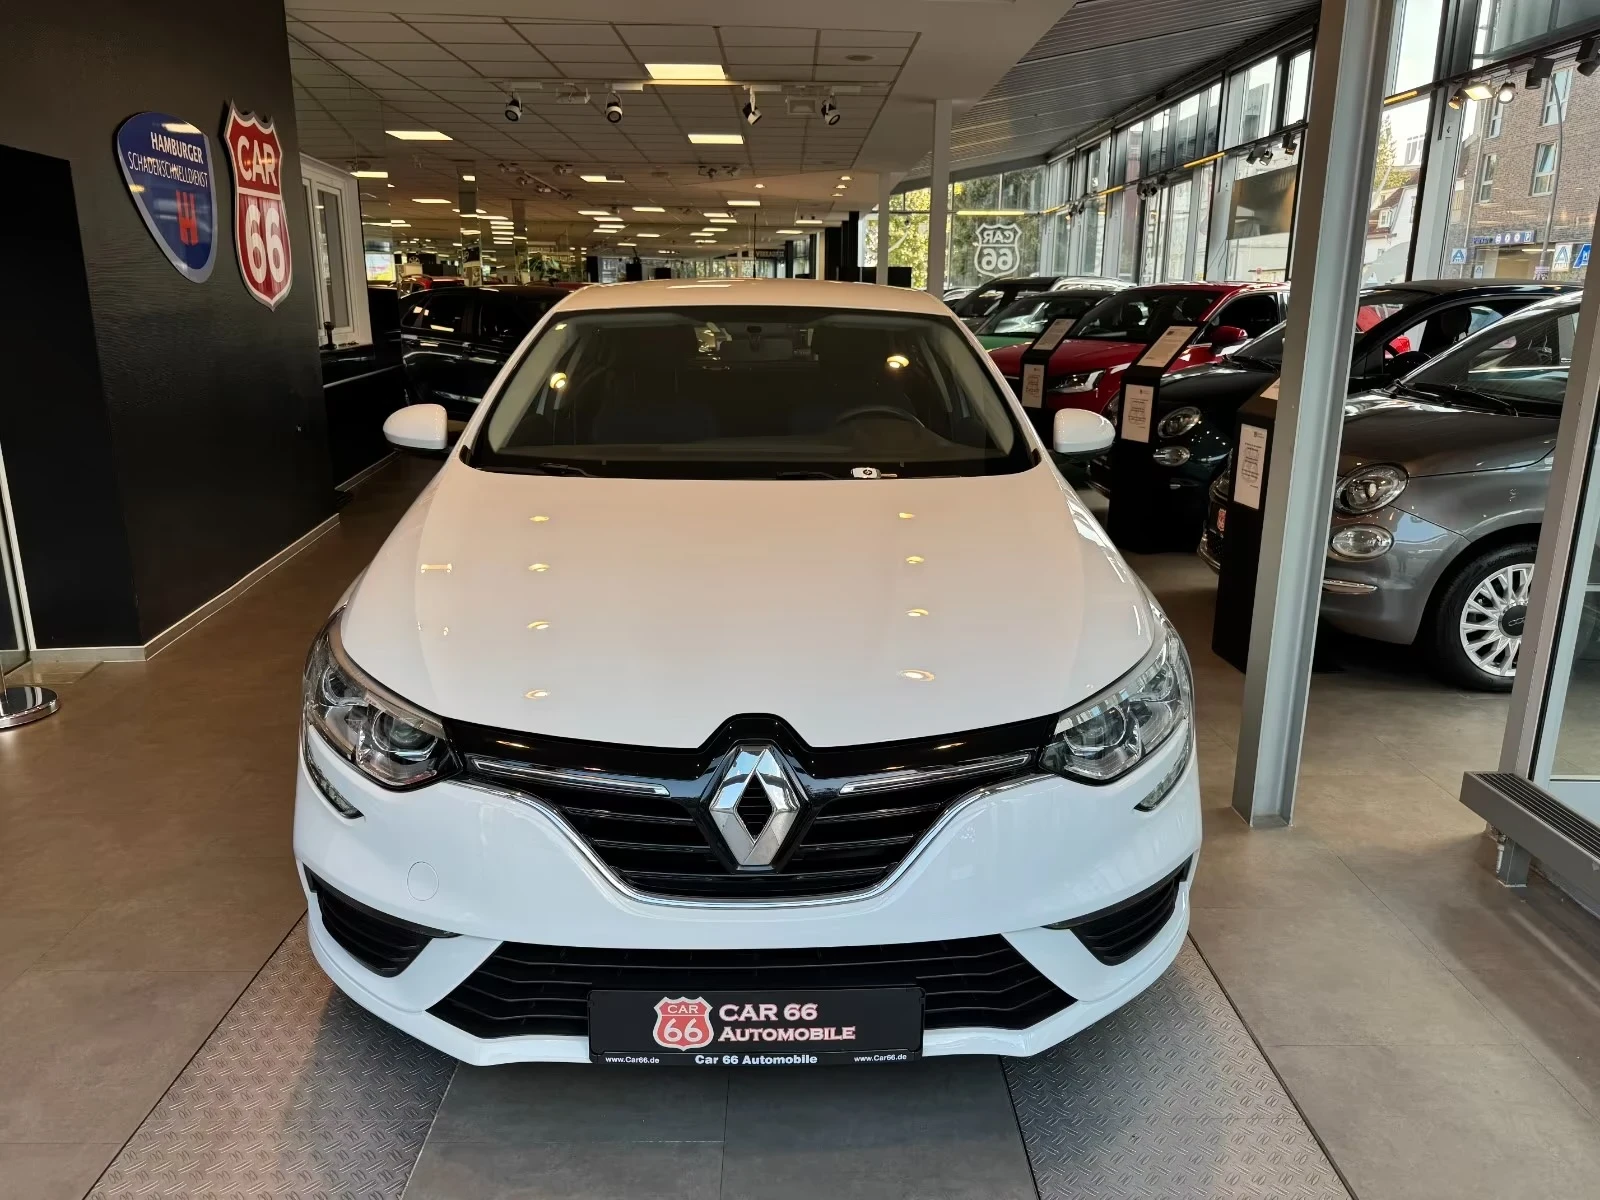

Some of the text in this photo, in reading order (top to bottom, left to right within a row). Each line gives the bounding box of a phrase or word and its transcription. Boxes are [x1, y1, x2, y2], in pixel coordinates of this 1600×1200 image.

[150, 131, 204, 164] HAMBURGER
[127, 151, 208, 188] SCHADENSCHNELLDIENST
[237, 135, 278, 187] CAR
[245, 204, 285, 284] 66
[667, 1004, 699, 1014] CAR
[718, 1003, 818, 1021] CAR 66
[663, 1018, 703, 1042] 66
[718, 1026, 856, 1042] AUTOMOBILE
[605, 1056, 660, 1064] www.Car66.de
[694, 1054, 818, 1065] Car 66 Automobile
[853, 1053, 908, 1063] www.Car66.de
